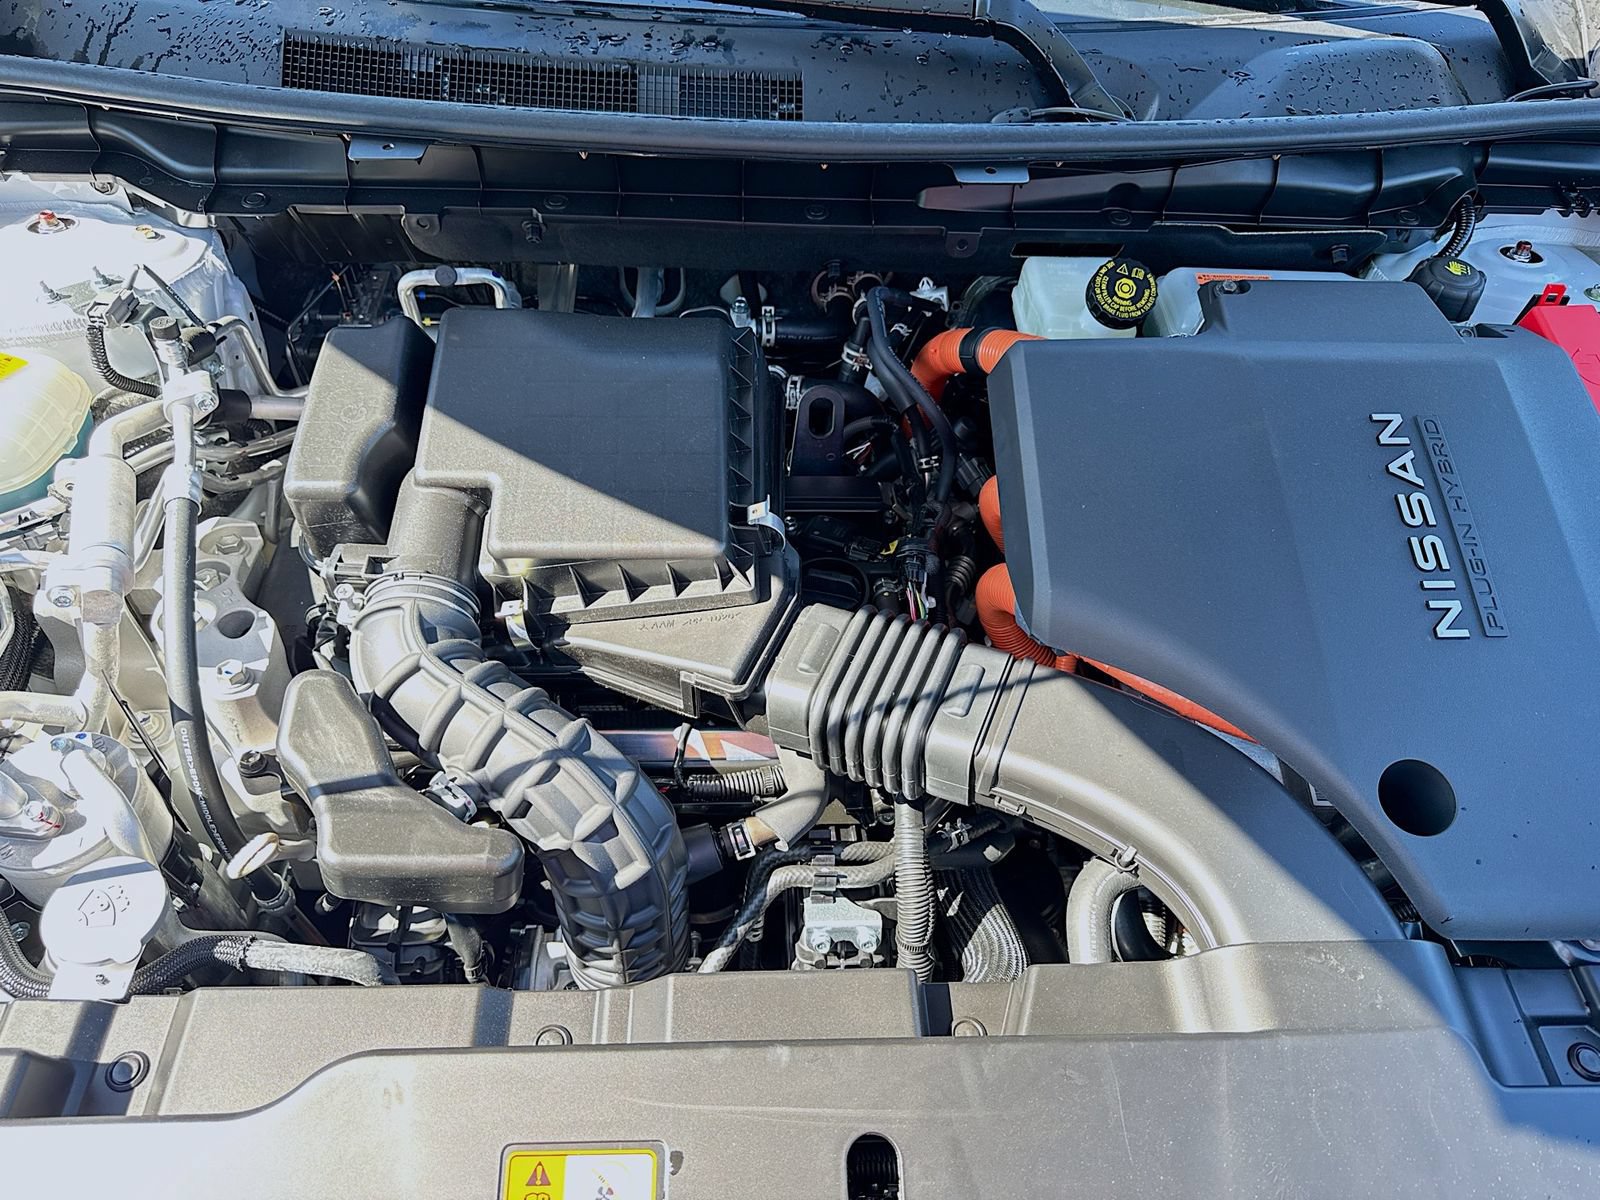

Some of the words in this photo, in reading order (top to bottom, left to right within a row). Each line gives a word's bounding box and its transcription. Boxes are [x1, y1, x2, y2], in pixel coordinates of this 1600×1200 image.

[1423, 419, 1467, 513] HYBRID
[1369, 413, 1470, 639] NISSAN
[1458, 523, 1504, 630] PLUG-IN
